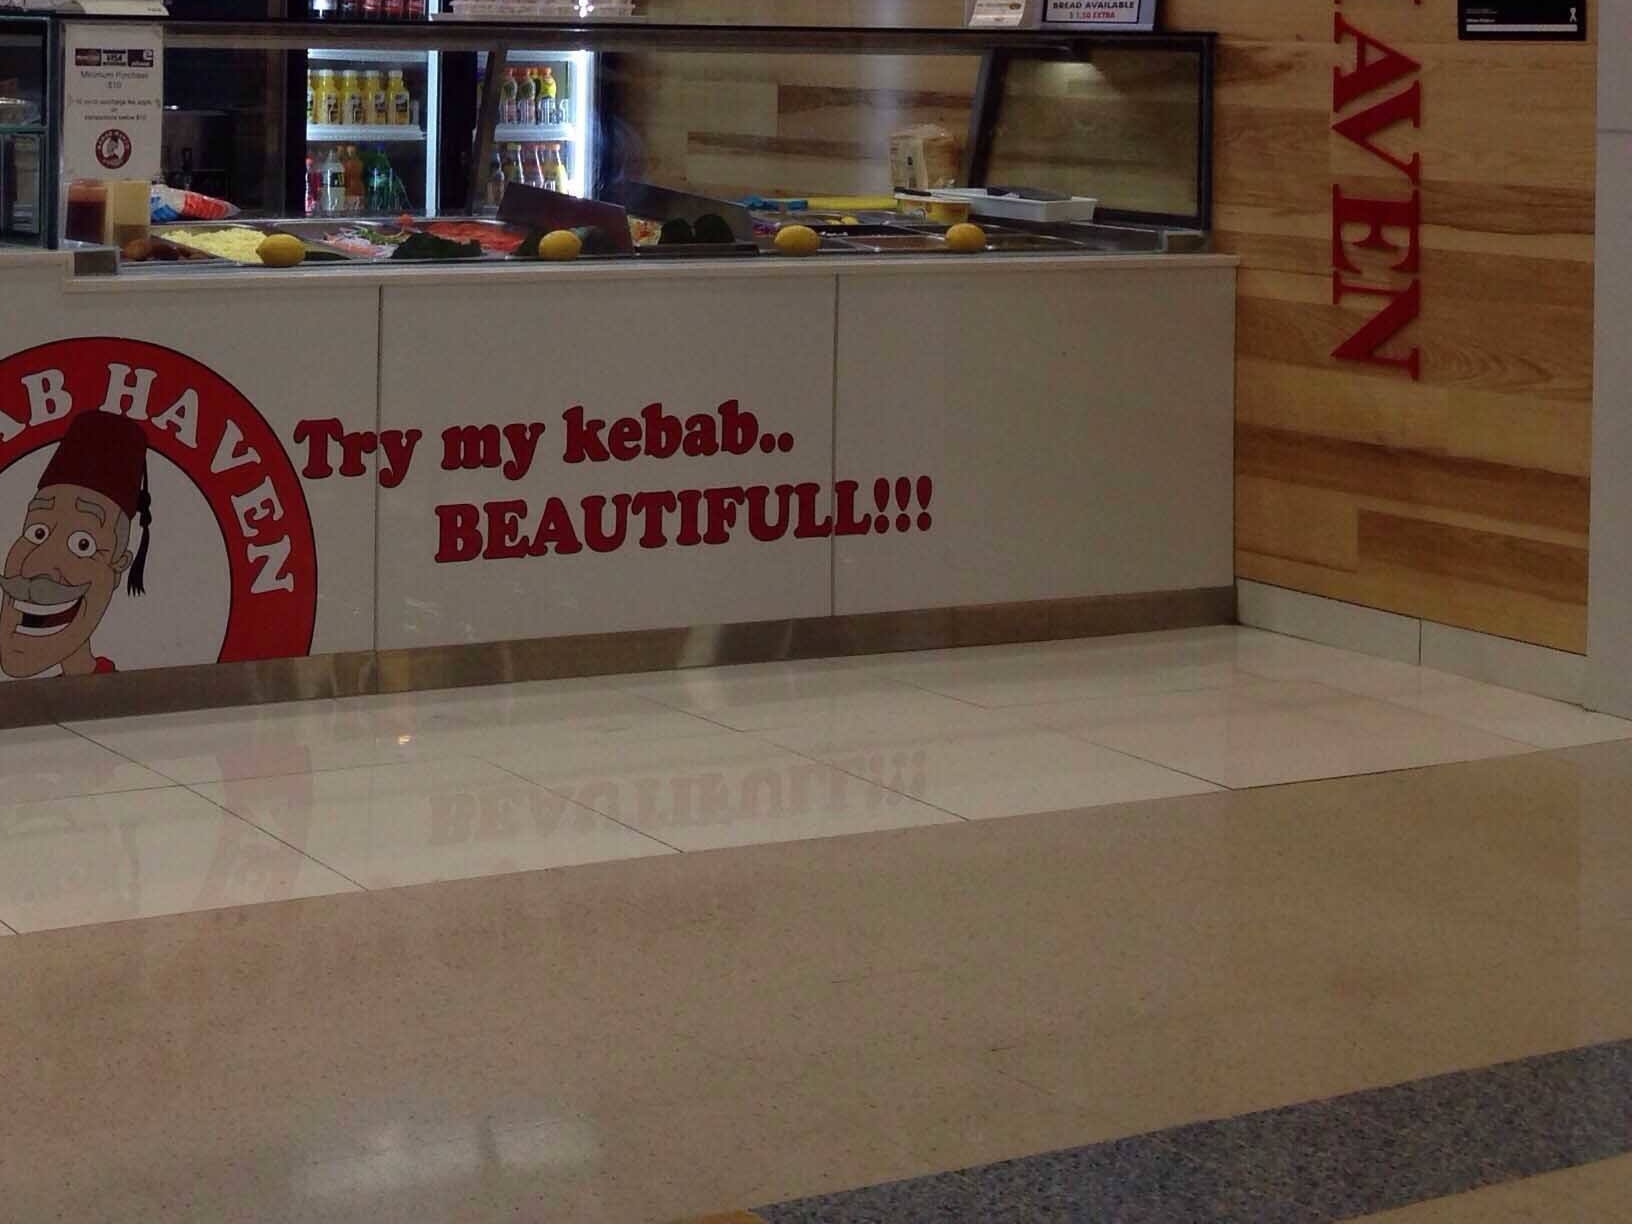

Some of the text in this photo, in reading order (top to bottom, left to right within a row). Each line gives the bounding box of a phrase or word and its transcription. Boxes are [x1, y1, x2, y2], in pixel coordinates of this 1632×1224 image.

[1052, 0, 1135, 10] BREAD AVAILABLE
[99, 363, 295, 594] HAVEN
[294, 399, 794, 488] Try my kebab..
[433, 475, 933, 563] BEAUTIFULL!!!
